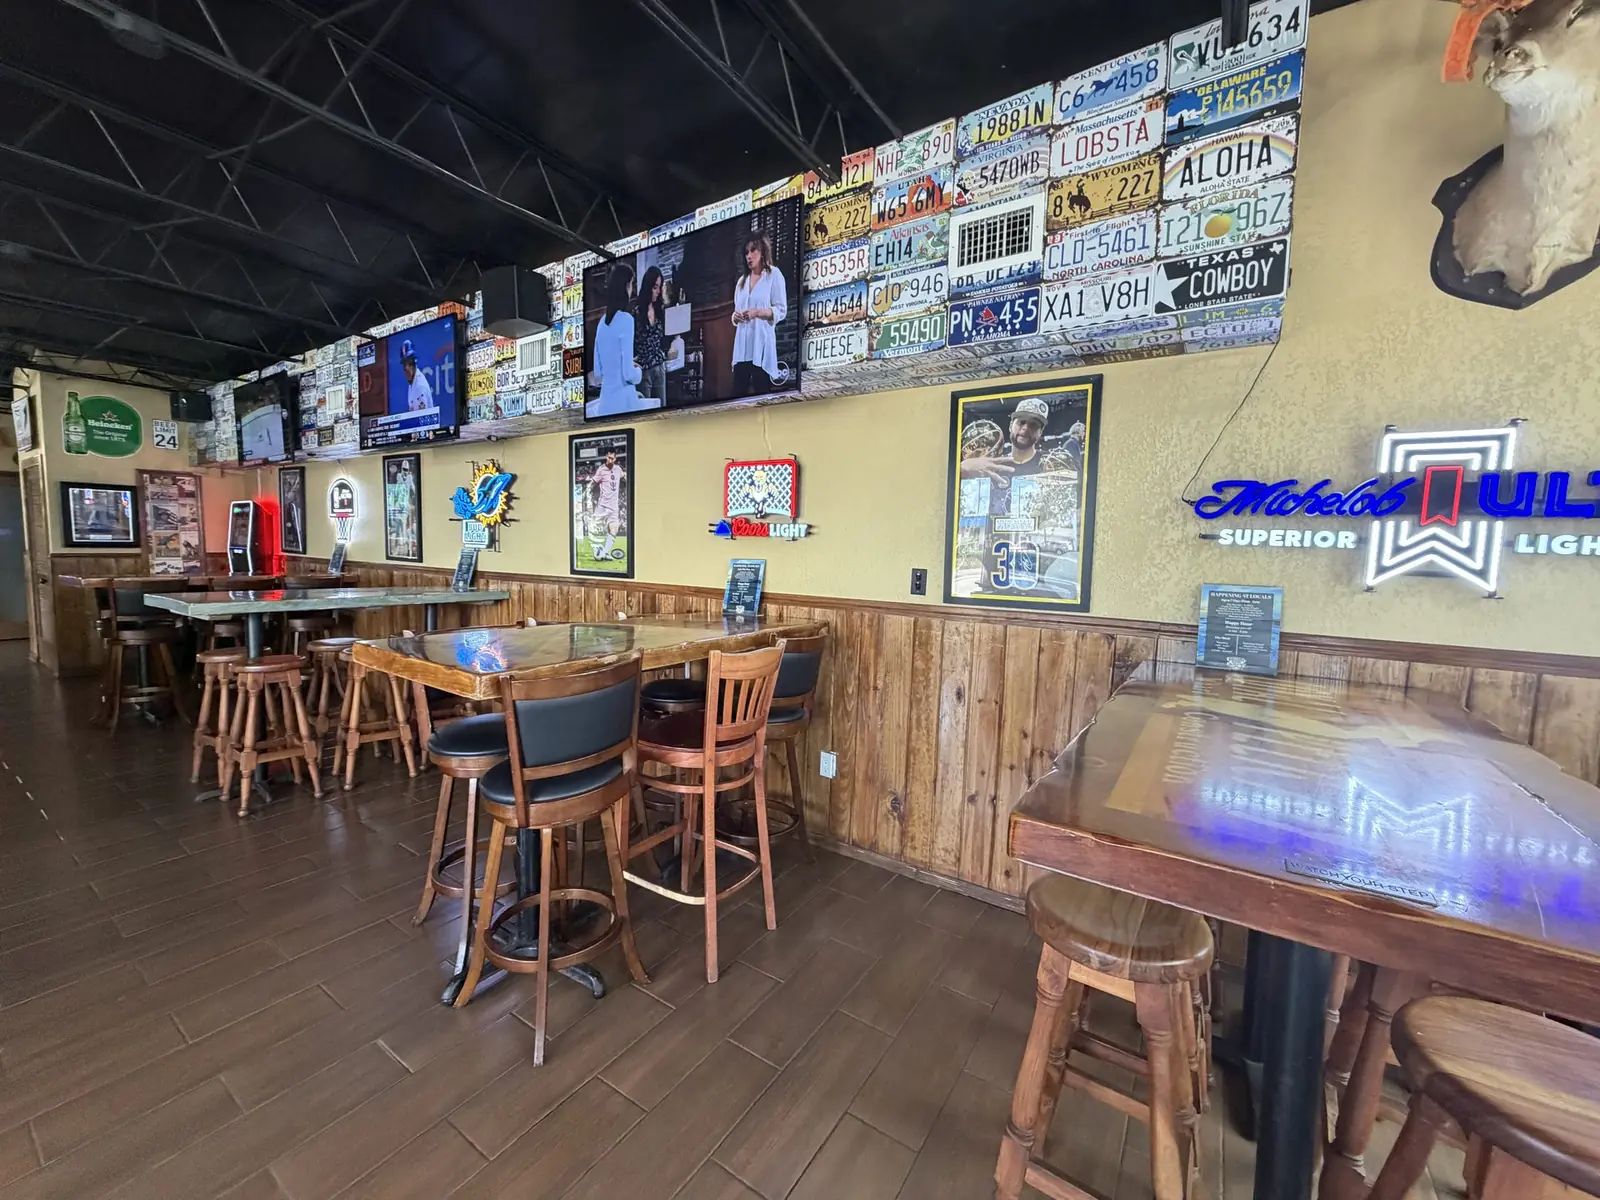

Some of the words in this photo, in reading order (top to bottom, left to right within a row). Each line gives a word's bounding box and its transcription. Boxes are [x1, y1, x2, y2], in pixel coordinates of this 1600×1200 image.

[1248, 5, 1300, 48] 634
[1080, 53, 1142, 81] KENTUCKY
[1060, 84, 1085, 113] C6
[1115, 59, 1159, 92] 458
[1197, 65, 1267, 97] DELAWARE
[1217, 70, 1292, 117] 145659
[974, 98, 1045, 144] 19881N
[978, 94, 1032, 121] NEVADA
[1073, 108, 1138, 137] Massachusetts
[1060, 118, 1149, 167] LOBSTA
[1211, 131, 1244, 147] HAWAII
[877, 150, 903, 178] NHP
[922, 132, 952, 163] 890
[977, 144, 1024, 164] VIRGINIA
[1180, 135, 1271, 188] ALOHA
[979, 150, 1040, 189] 5470WB
[898, 175, 925, 192] UTAH
[915, 179, 946, 212] 6MY
[1052, 197, 1063, 218] 8
[1116, 170, 1154, 202] 227
[1200, 181, 1226, 194] ALOHA
[1190, 187, 1258, 213] FLORIDA
[804, 222, 811, 242] 8
[844, 205, 867, 230] 227
[891, 223, 930, 240] Arkansas
[875, 236, 913, 267] EH14
[1183, 237, 1226, 253] SUNSHINE
[1186, 246, 1255, 270] TEXAS
[1052, 265, 1088, 281] NORTH
[1091, 254, 1145, 274] CAROLINA
[1189, 257, 1274, 299] COWBOY
[911, 272, 944, 299] 946
[1044, 289, 1085, 323] XA1
[1101, 276, 1150, 313] V8H
[1185, 301, 1205, 310] LONE
[1207, 297, 1227, 306] STAR
[1228, 293, 1252, 303] STATE
[950, 308, 973, 335] PN
[999, 296, 1038, 324] 455
[889, 316, 940, 348] 59490
[971, 330, 1011, 343] OKLAHOMA
[808, 334, 854, 361] CHEESE
[882, 344, 924, 359] Vermont
[87, 419, 131, 431] Heineken
[155, 434, 179, 448] 24
[1194, 476, 1416, 519] Michelob
[731, 517, 769, 538] Coors
[769, 523, 806, 538] LIGHT
[1217, 528, 1357, 550] SUPERIOR
[990, 541, 1039, 591] 30
[1250, 593, 1272, 601] LOCALS
[1386, 882, 1430, 899] STEP
